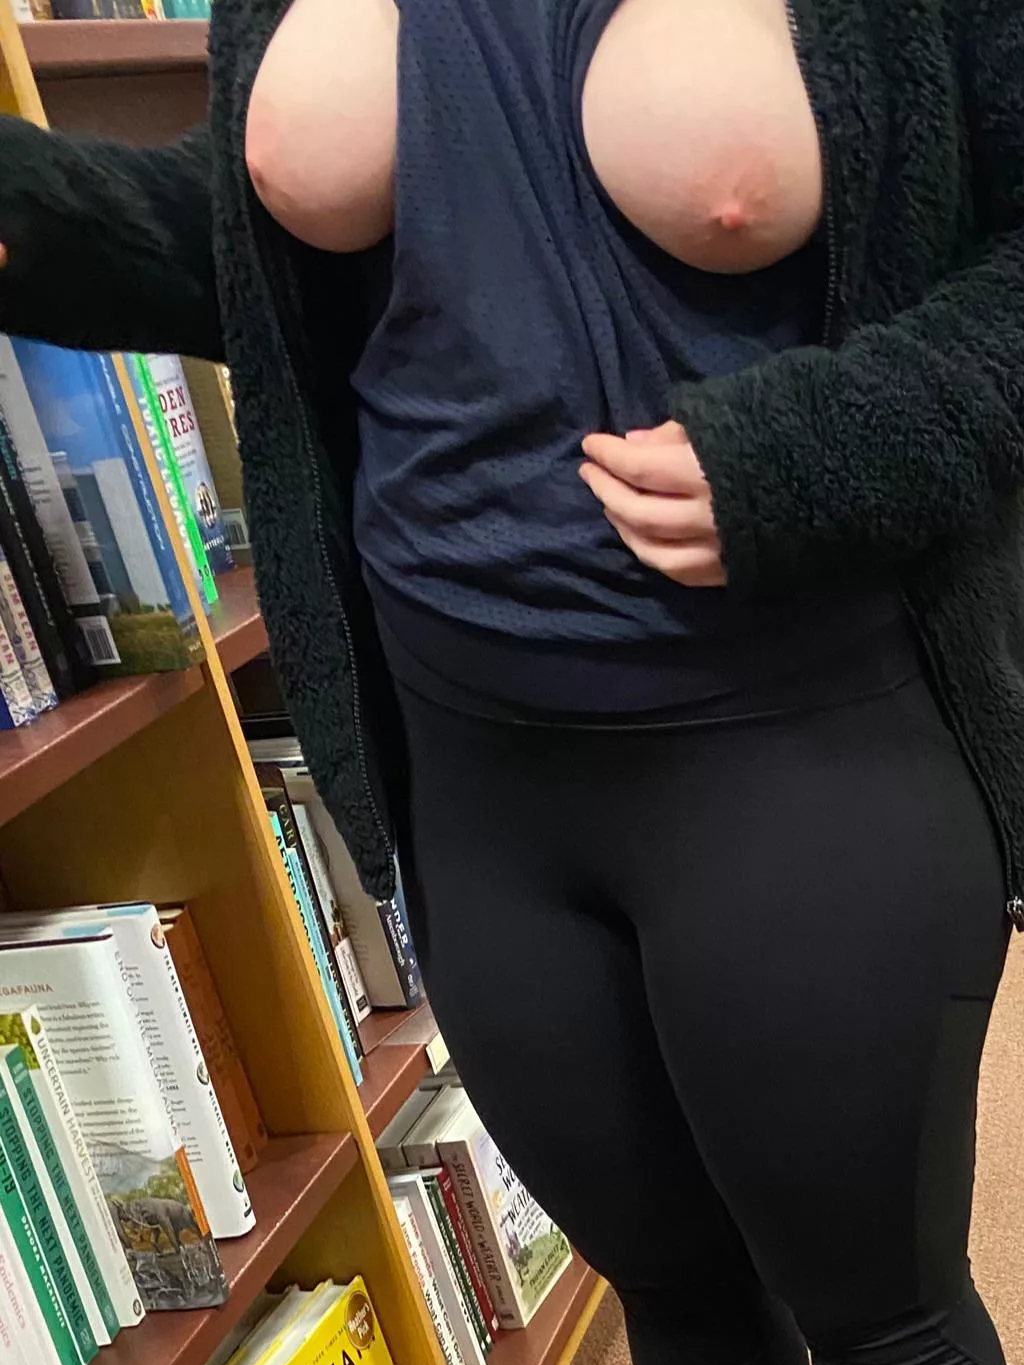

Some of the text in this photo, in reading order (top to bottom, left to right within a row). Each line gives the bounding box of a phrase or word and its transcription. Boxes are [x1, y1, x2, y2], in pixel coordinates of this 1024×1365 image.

[120, 423, 166, 550] CONSTRUCTION
[168, 411, 195, 438] RES
[1, 573, 39, 652] SAM KEAN
[0, 984, 54, 997] GAFAUNA
[385, 913, 405, 967] Attenborough
[112, 950, 182, 1137] END OF THE MEGAFAUNA
[34, 1037, 73, 1115] UNCERTAIN
[63, 1117, 97, 1183] HARVEST
[0, 1106, 85, 1327] STOPPING THE NEXT PANDEMIC
[21, 1087, 108, 1303] STOPPING THE NEXT PANDEMIC
[451, 1160, 474, 1199] SECRET
[464, 1199, 485, 1233] WORLD
[399, 1221, 414, 1248] Jane
[409, 1251, 427, 1288] Fonda
[423, 1289, 439, 1321] What
[434, 1322, 447, 1346] Can
[407, 1212, 421, 1239] Jane
[417, 1241, 434, 1278] Fonda
[430, 1279, 445, 1309] What
[440, 1310, 453, 1334] Can
[451, 1342, 463, 1364] Do?
